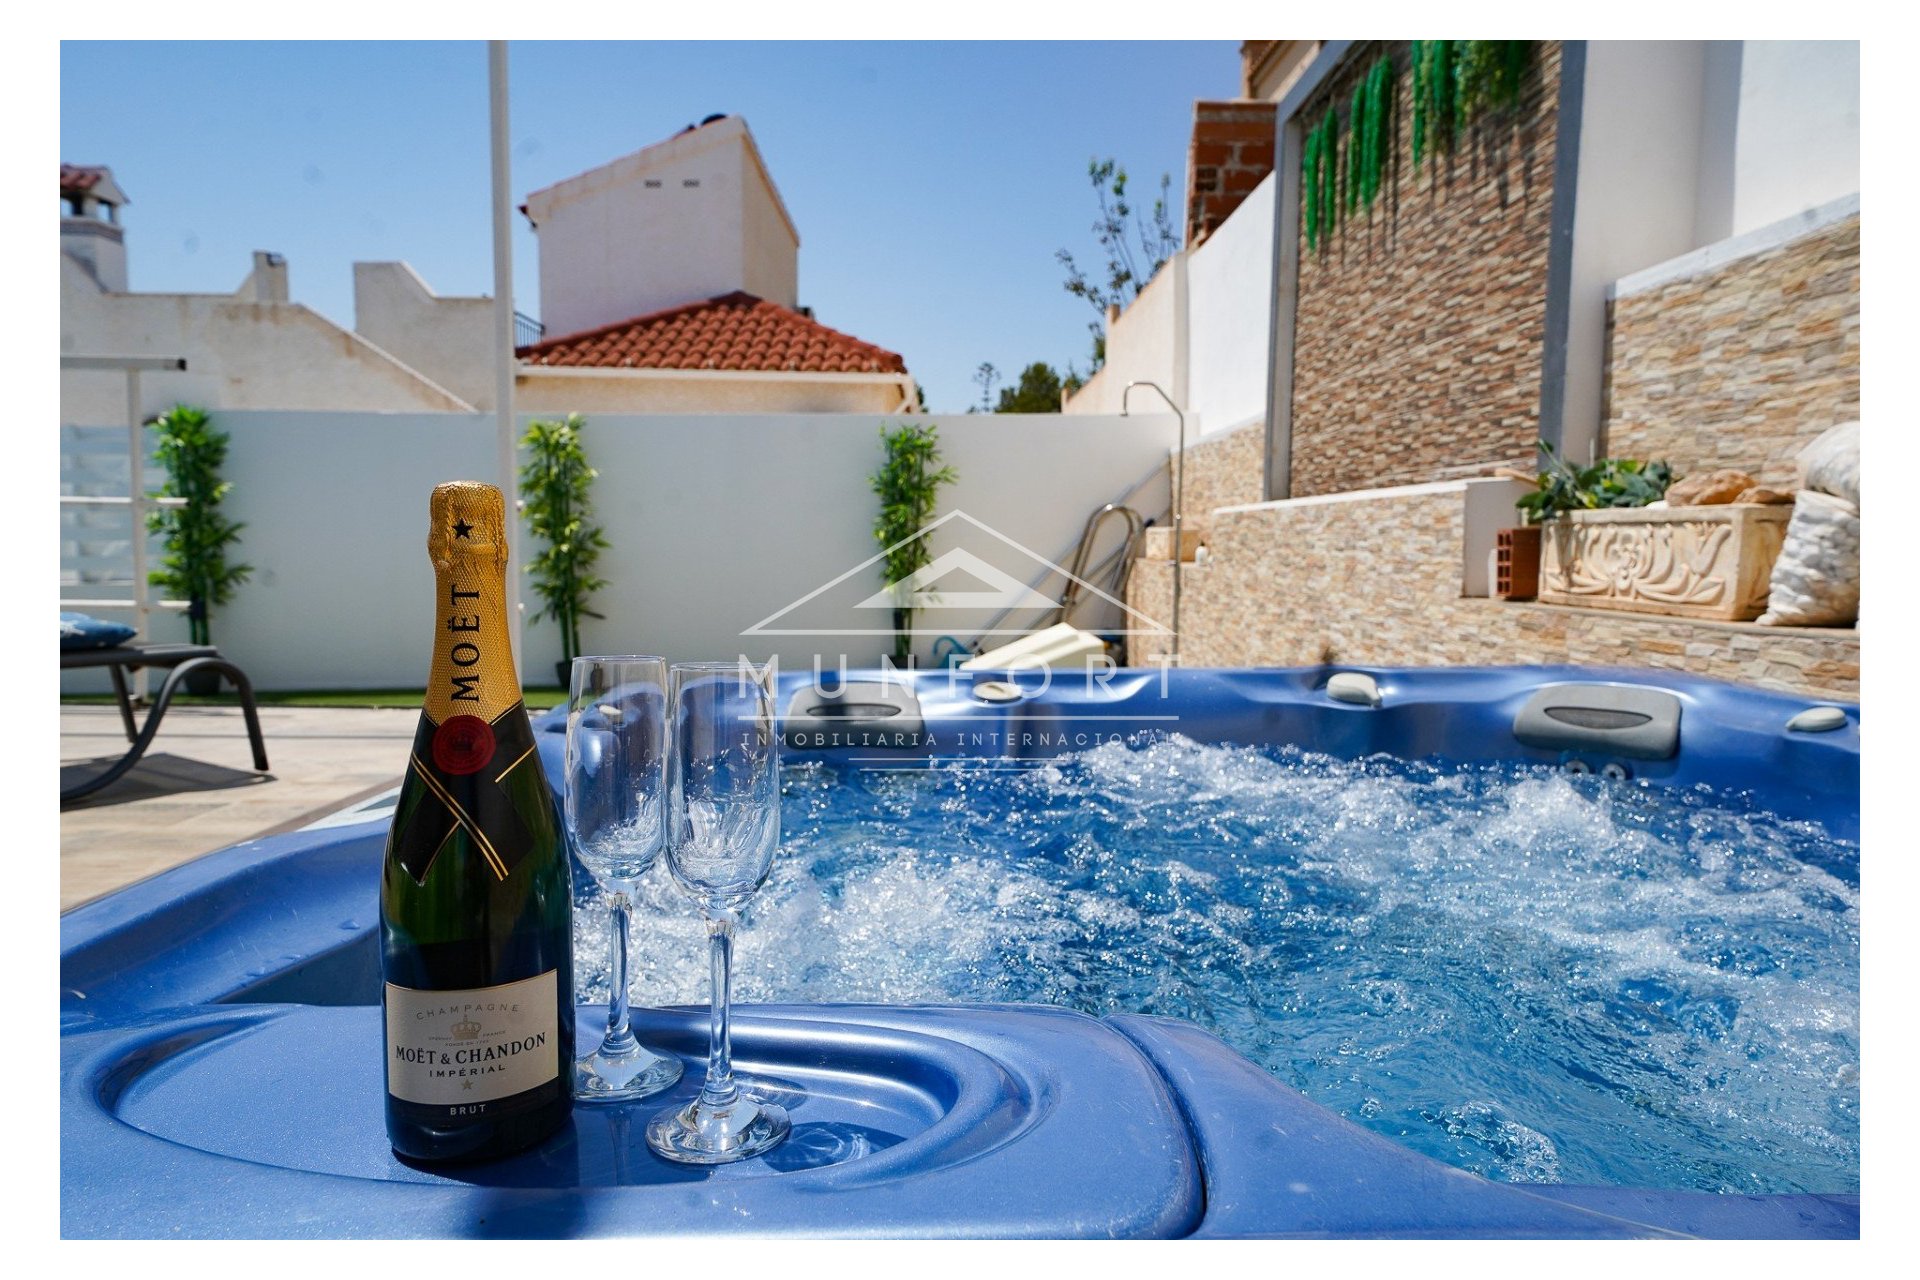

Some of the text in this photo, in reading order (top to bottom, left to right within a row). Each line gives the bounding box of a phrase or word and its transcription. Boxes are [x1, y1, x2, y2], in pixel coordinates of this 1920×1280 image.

[448, 585, 480, 702] MOËT
[416, 1003, 519, 1020] CHAMPAGNE
[395, 1032, 546, 1065] MOËT & CHANDON
[429, 1064, 506, 1078] IMPÉRIAL
[450, 1104, 487, 1116] BRUT
